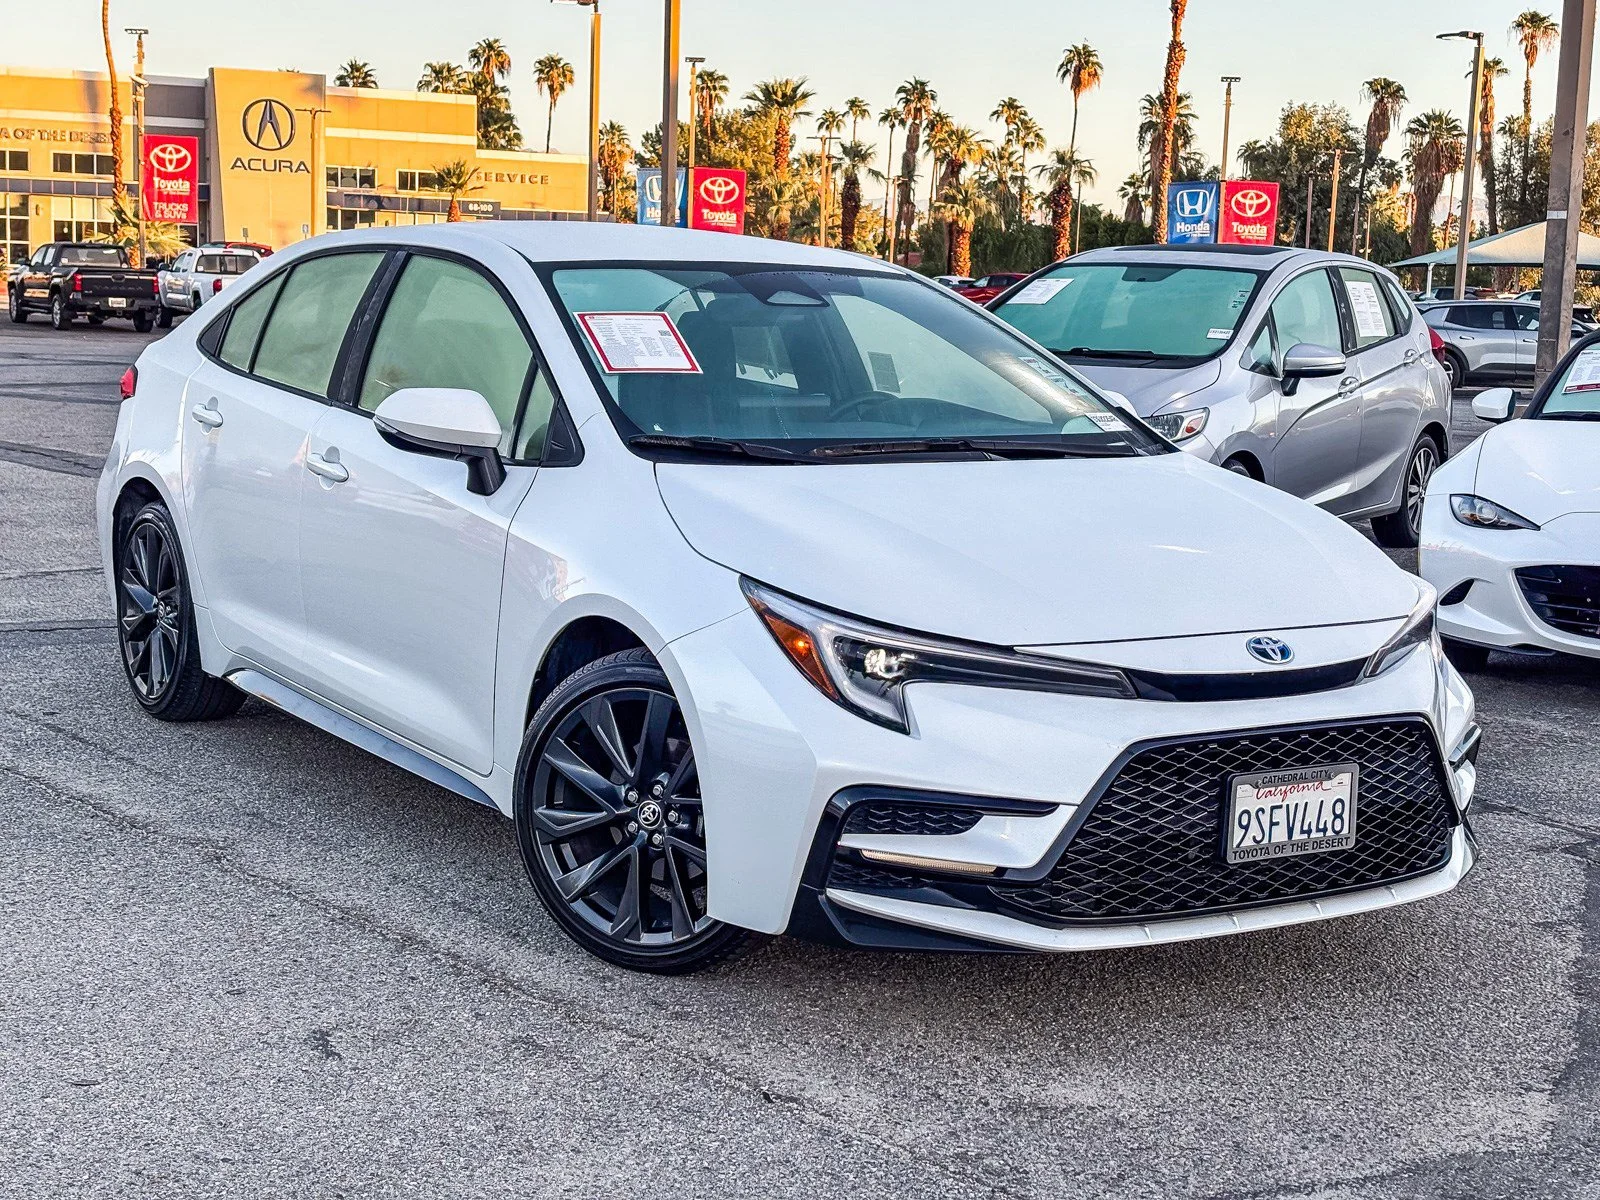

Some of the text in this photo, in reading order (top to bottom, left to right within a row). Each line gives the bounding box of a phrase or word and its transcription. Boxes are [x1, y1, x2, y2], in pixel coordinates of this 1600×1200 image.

[14, 128, 35, 140] OF
[38, 129, 66, 142] THE
[230, 157, 310, 173] ACURA
[153, 177, 190, 190] Toyota
[476, 171, 549, 185] SERVICE
[153, 202, 188, 212] TRUCKS
[647, 207, 680, 218] Hoa
[155, 210, 162, 218] &
[701, 209, 737, 221] Toyota
[1177, 222, 1210, 233] Honda
[1232, 223, 1267, 234] Toyota
[1262, 770, 1329, 785] CATHEDRAL CITY
[1256, 781, 1332, 803] California
[1235, 797, 1346, 849] 9SFV448
[1232, 837, 1351, 861] TOYOTA OF THE DESERT
